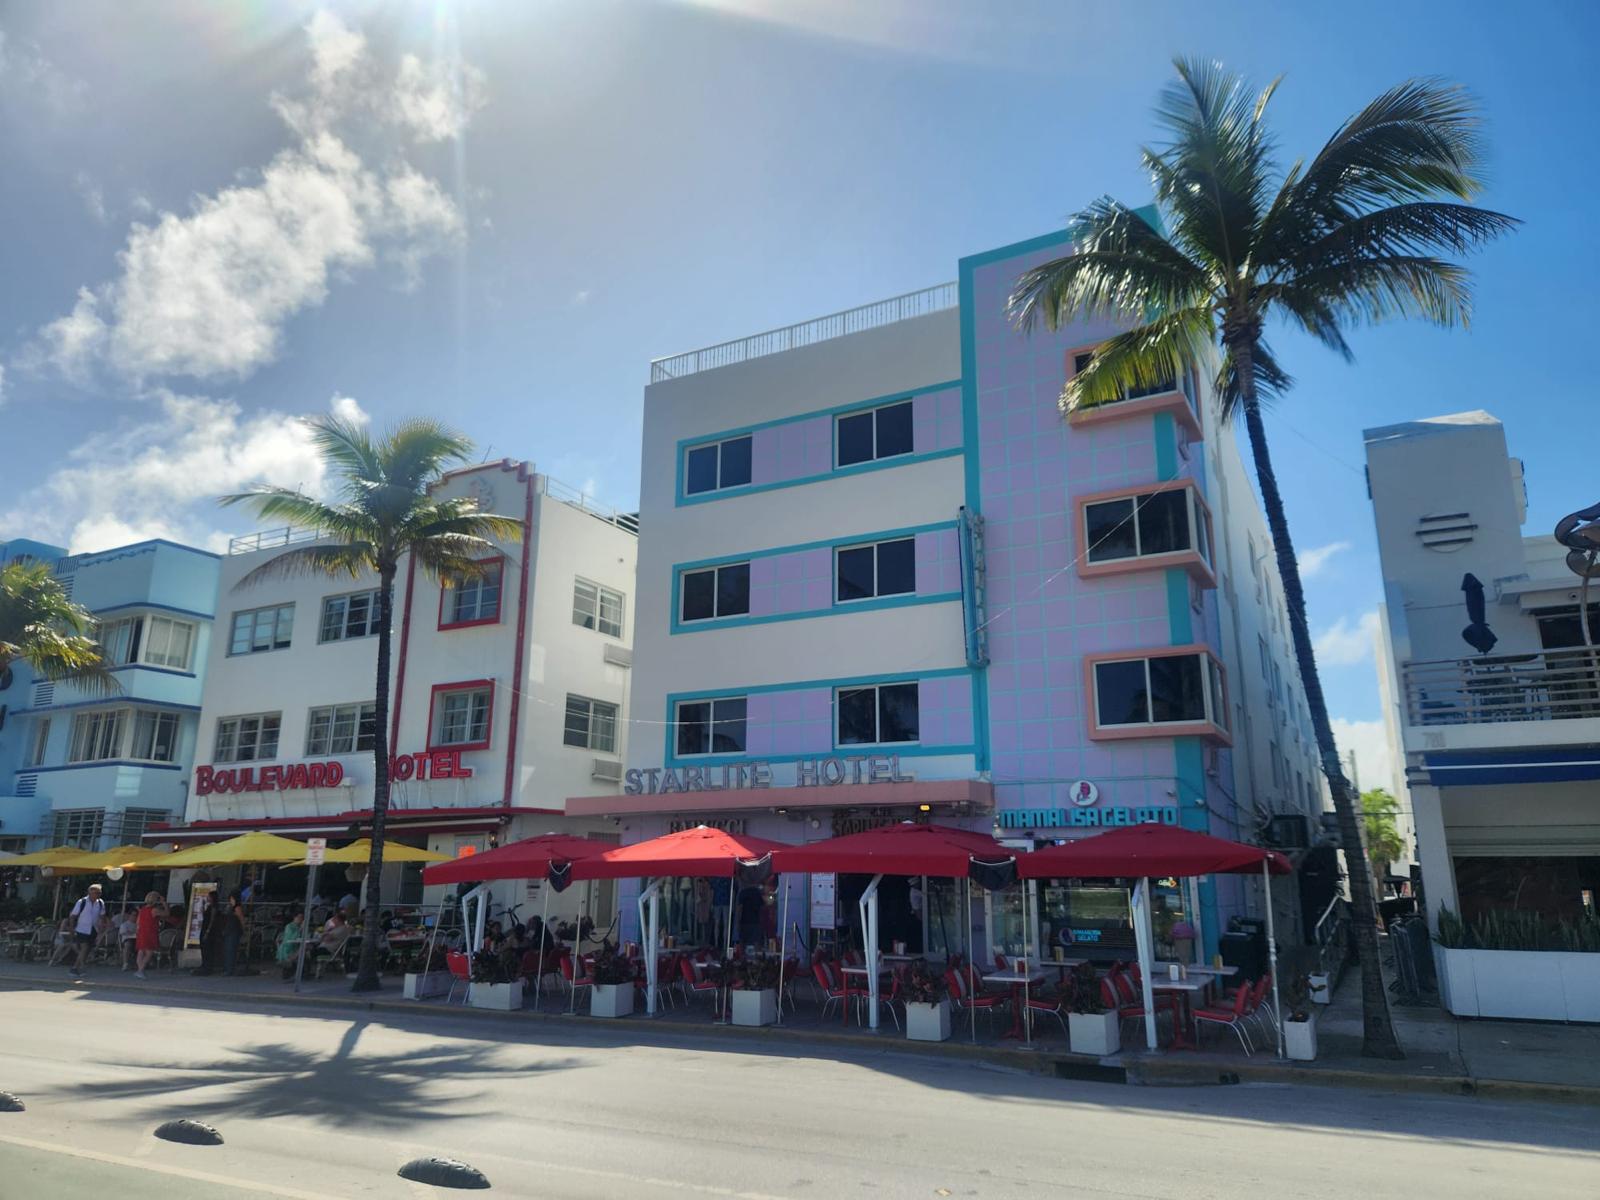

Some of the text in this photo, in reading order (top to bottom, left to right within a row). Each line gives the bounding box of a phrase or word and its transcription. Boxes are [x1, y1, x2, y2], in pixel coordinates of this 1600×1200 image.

[196, 762, 344, 796] BOULEVARD
[624, 754, 914, 795] STARLITE HOTEL
